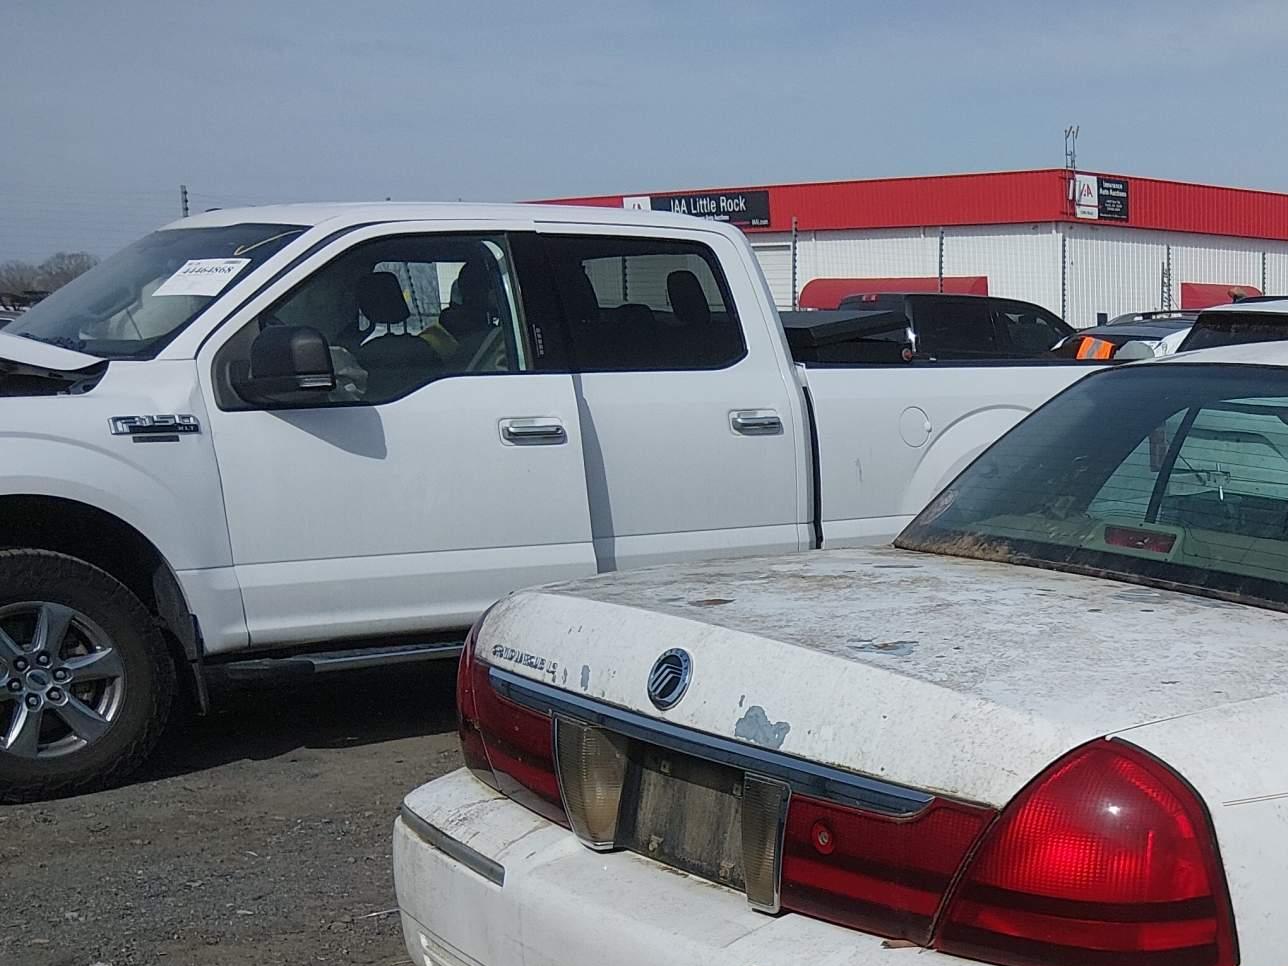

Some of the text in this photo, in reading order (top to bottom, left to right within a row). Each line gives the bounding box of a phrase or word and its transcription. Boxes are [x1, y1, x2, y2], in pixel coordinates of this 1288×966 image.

[671, 195, 747, 214] IAA Little Rock
